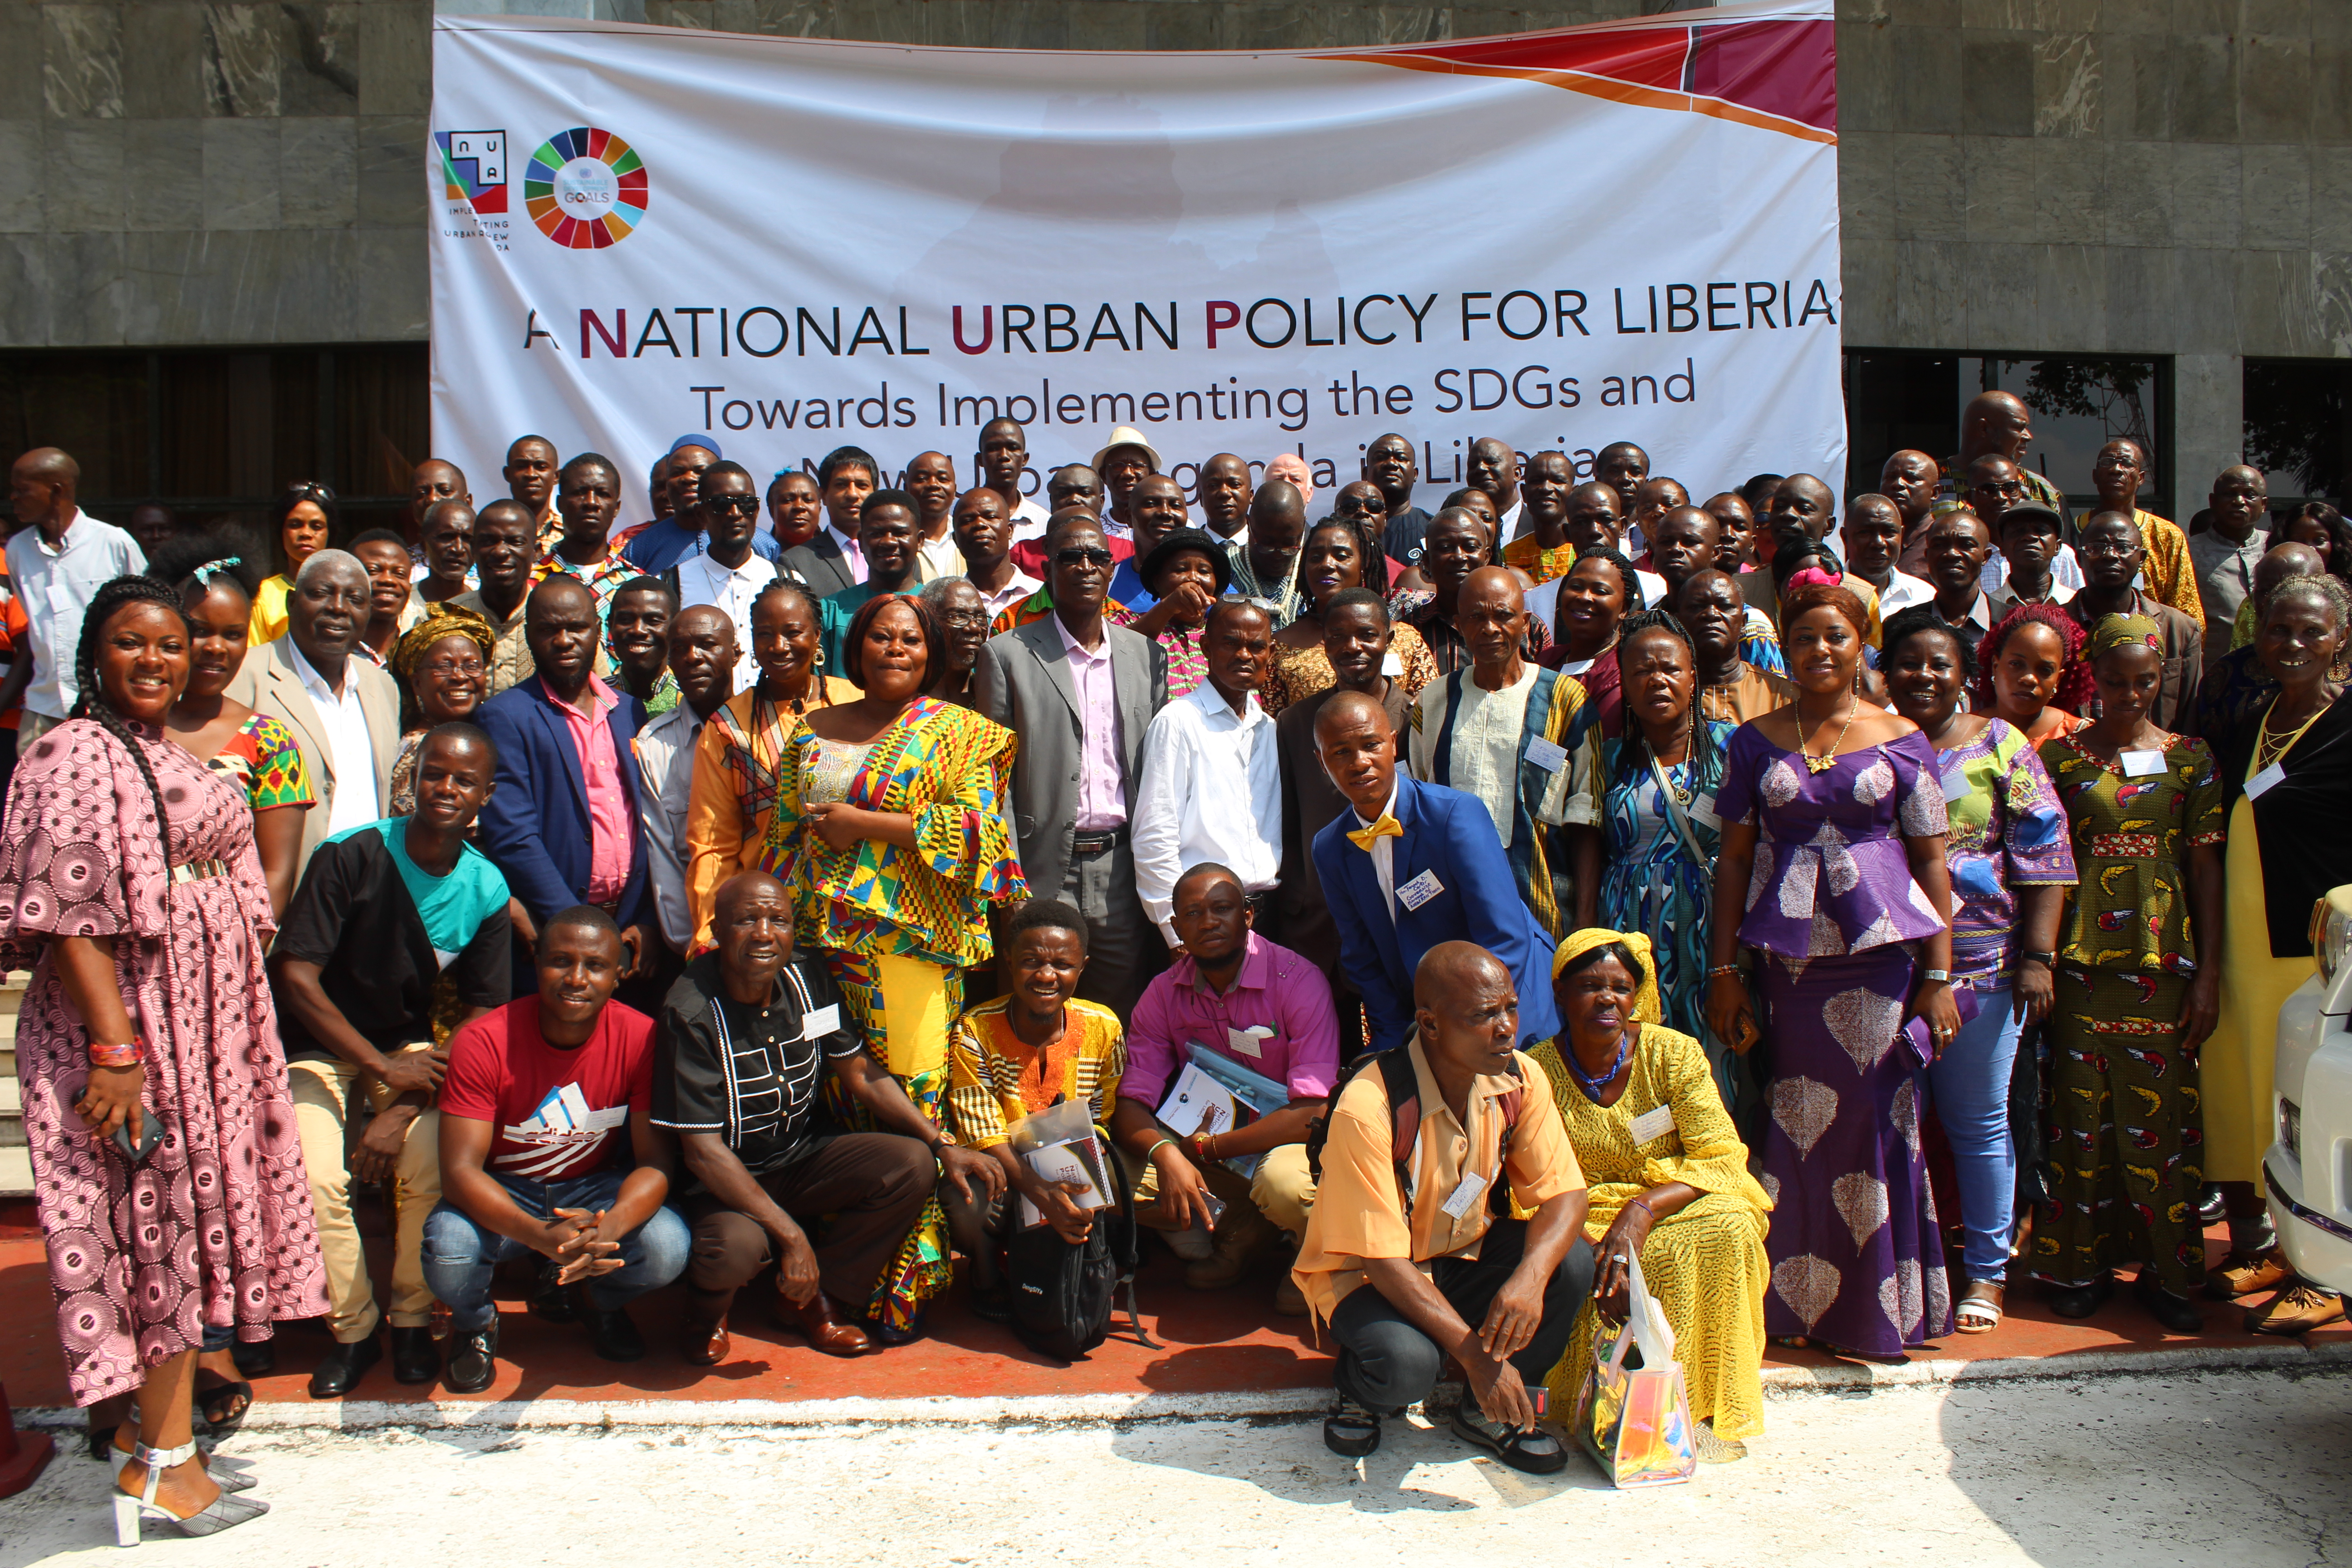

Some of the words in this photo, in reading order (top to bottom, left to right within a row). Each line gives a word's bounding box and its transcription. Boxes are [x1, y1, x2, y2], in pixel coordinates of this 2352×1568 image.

[565, 192, 609, 203] GOALS
[445, 230, 476, 238] URBAN
[524, 309, 561, 350] A
[580, 306, 930, 358] NATIONAL
[952, 301, 1178, 355] URBAN
[1206, 293, 1438, 349] POLICY
[1462, 289, 1590, 341] FOR
[1614, 279, 1837, 334] LIBERIA
[690, 381, 916, 431] Towards
[939, 376, 1308, 431] Implementing
[1329, 369, 1413, 416] the
[1434, 365, 1581, 413] SDGs
[1601, 358, 1695, 407] and
